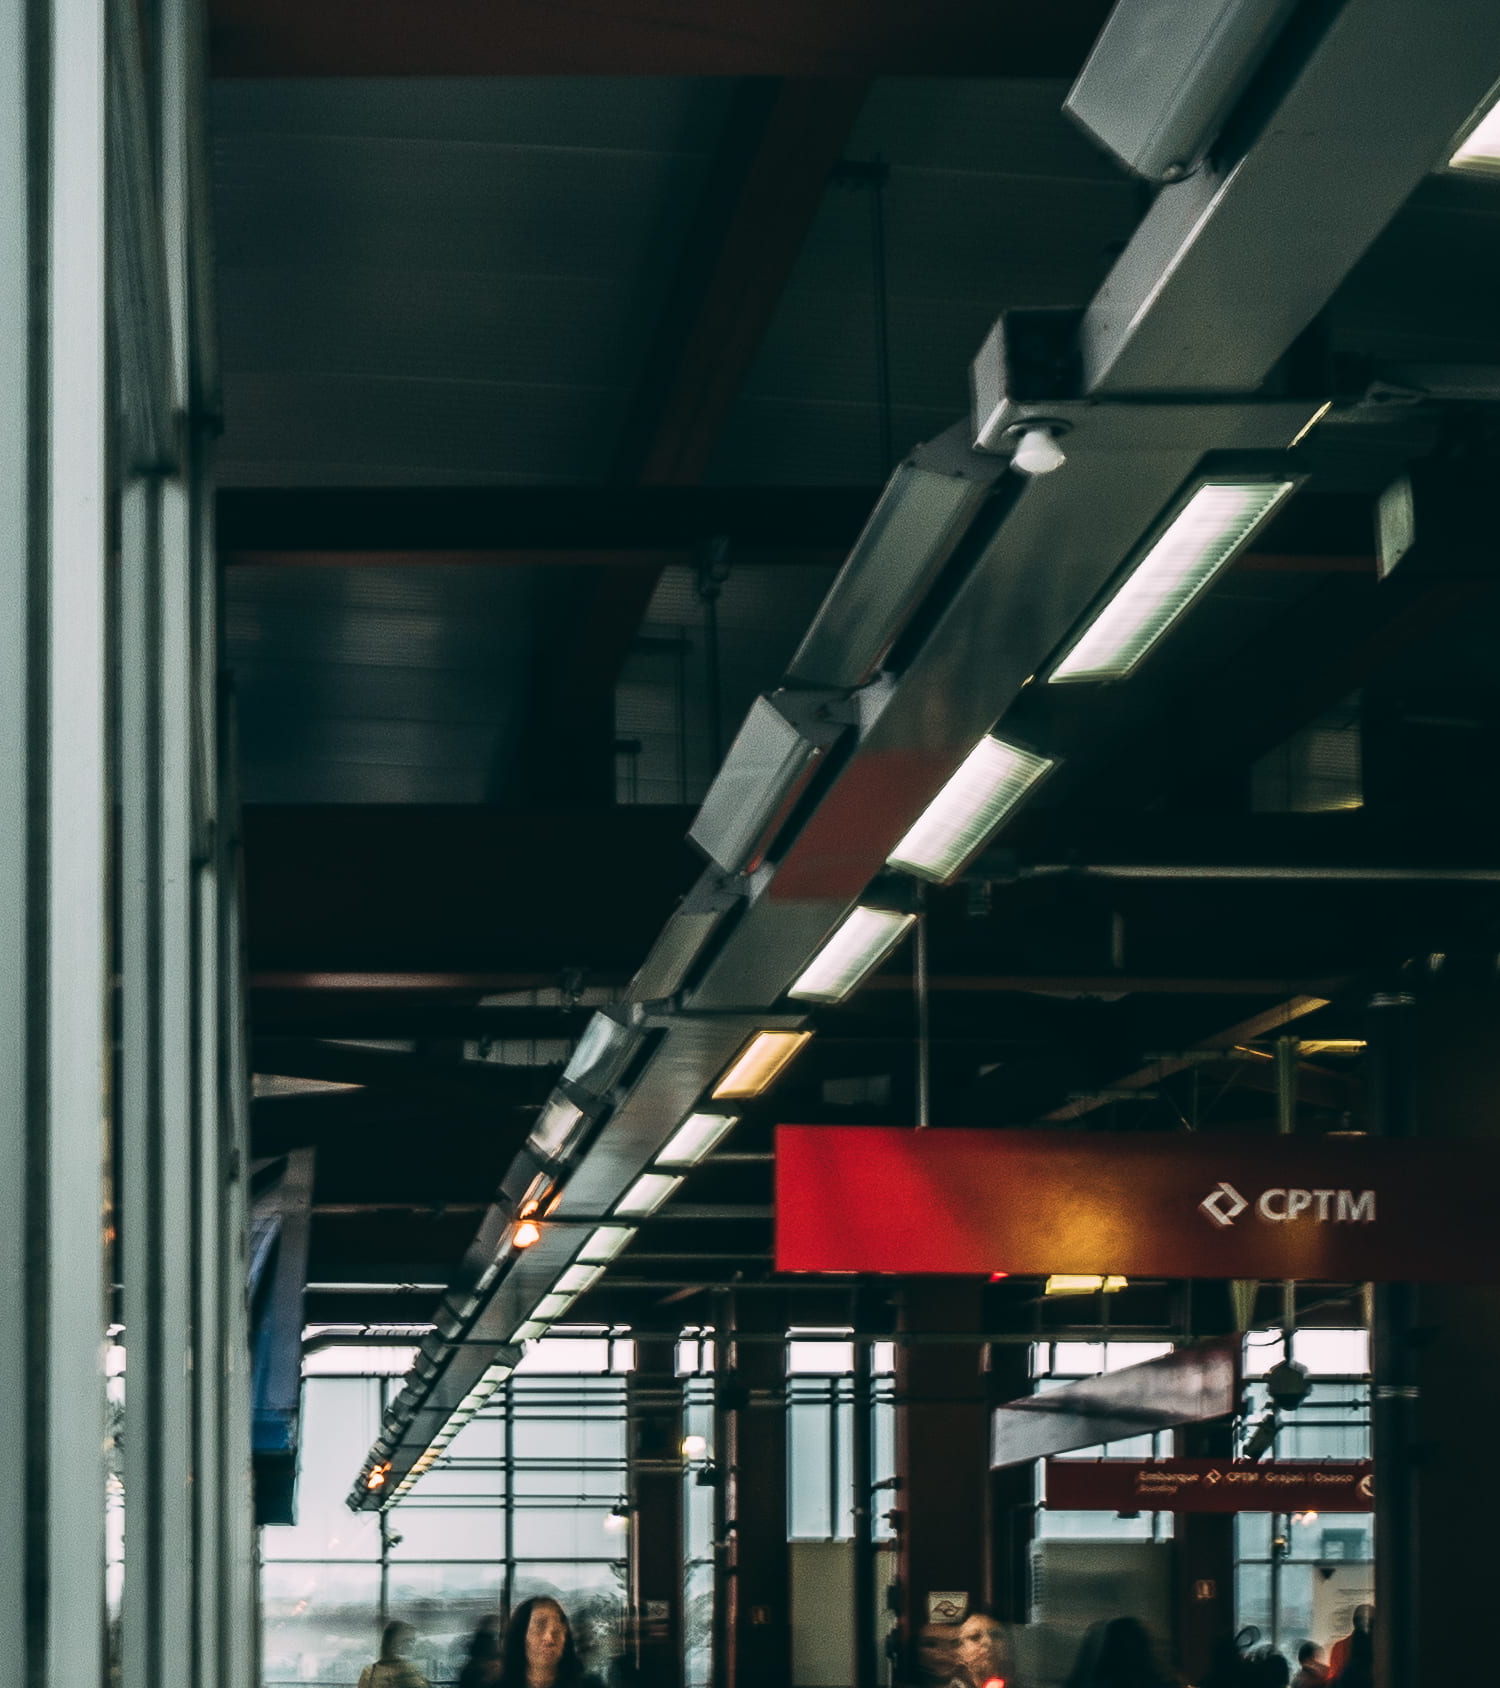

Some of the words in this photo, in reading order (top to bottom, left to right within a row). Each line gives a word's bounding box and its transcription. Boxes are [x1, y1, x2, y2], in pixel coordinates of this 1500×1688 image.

[1259, 1187, 1377, 1222] CPTM
[1138, 1471, 1200, 1484] Embarque
[1313, 1472, 1355, 1483] Osasco
